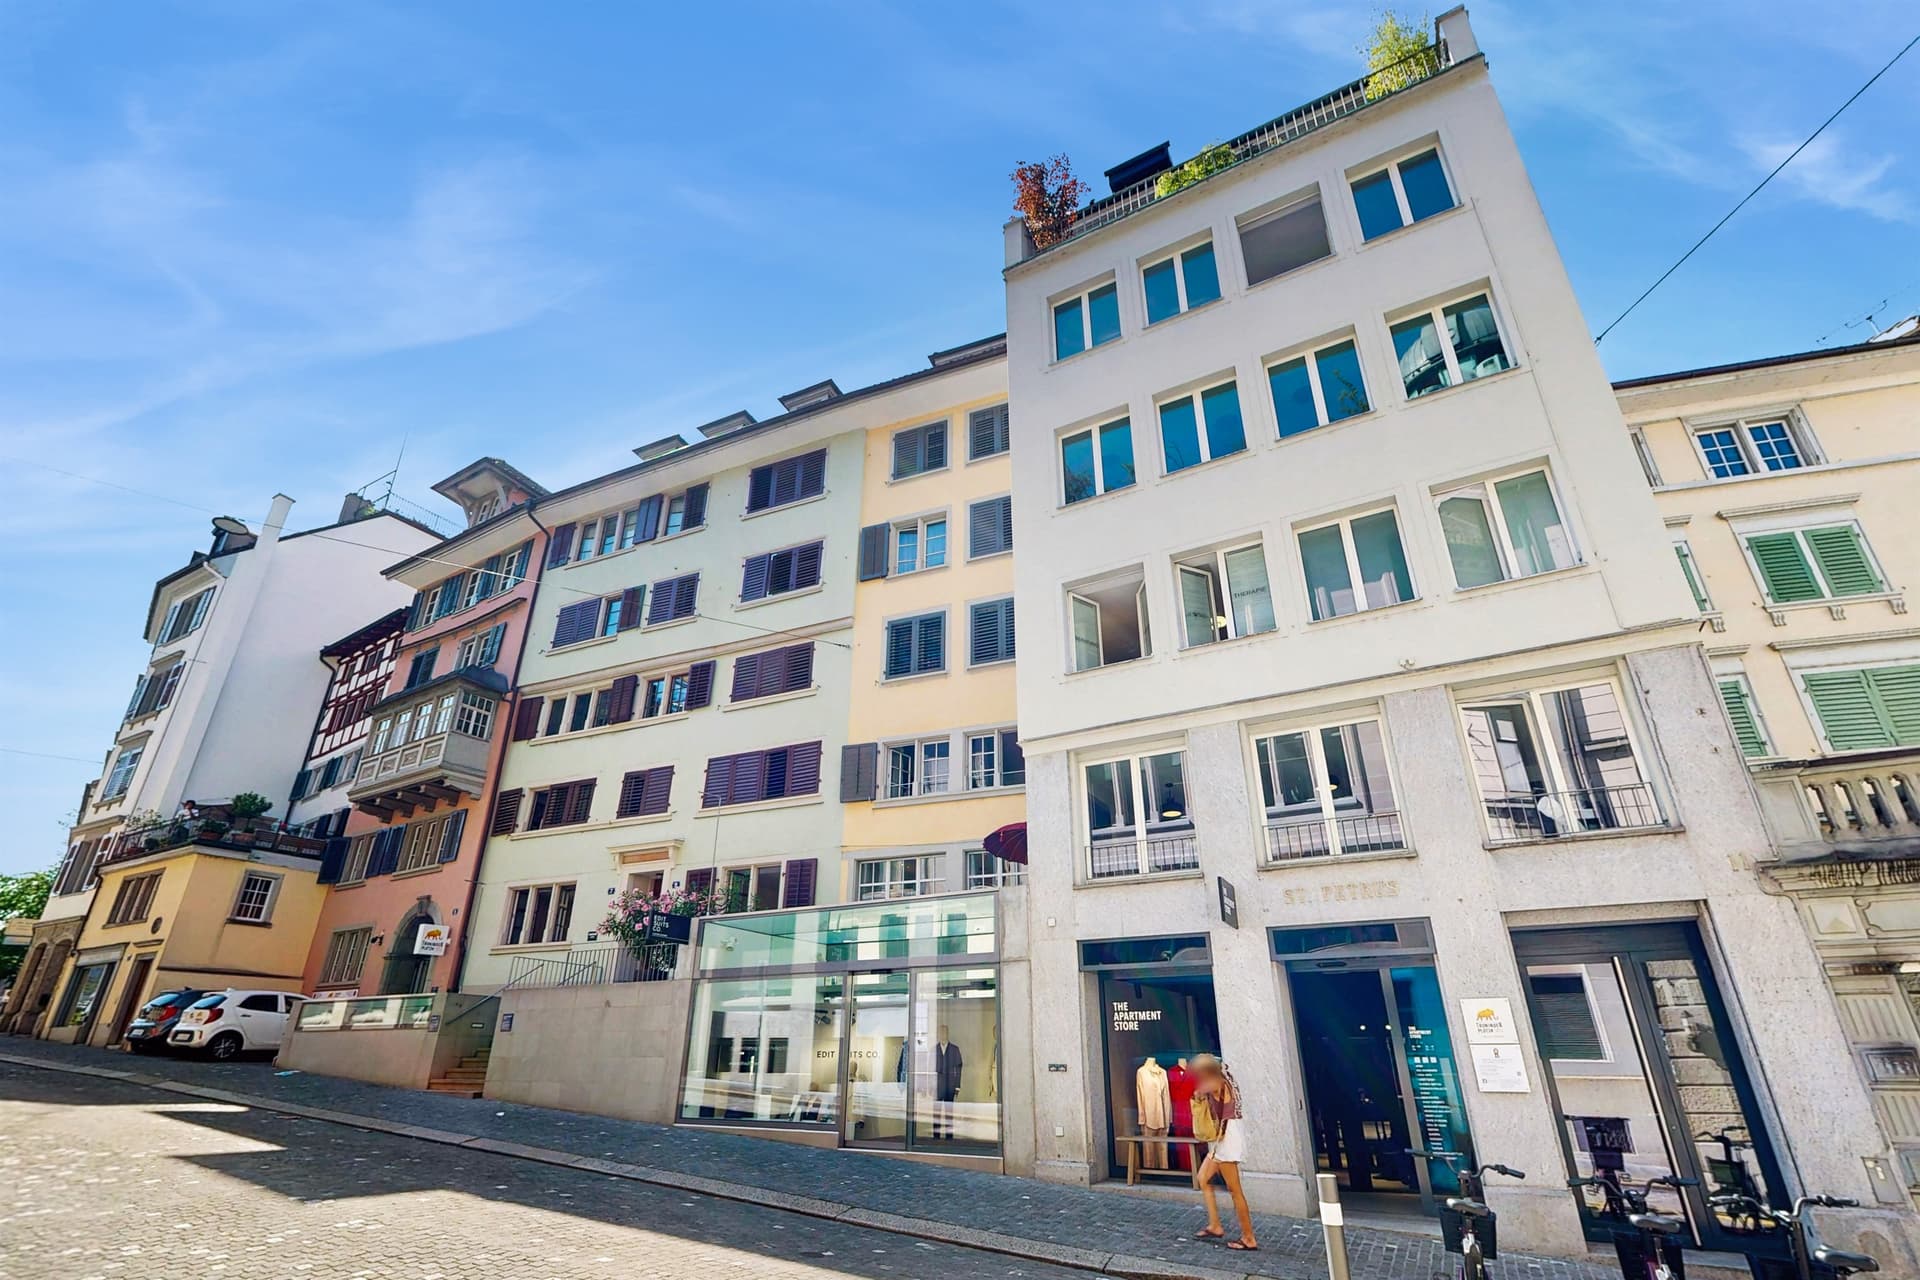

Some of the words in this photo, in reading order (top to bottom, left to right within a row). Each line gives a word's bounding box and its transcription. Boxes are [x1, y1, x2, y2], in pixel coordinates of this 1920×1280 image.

[1112, 1001, 1128, 1011] THE
[1113, 1010, 1161, 1021] APARTMENT
[1114, 1021, 1139, 1031] STORE
[816, 1050, 836, 1059] EDIT
